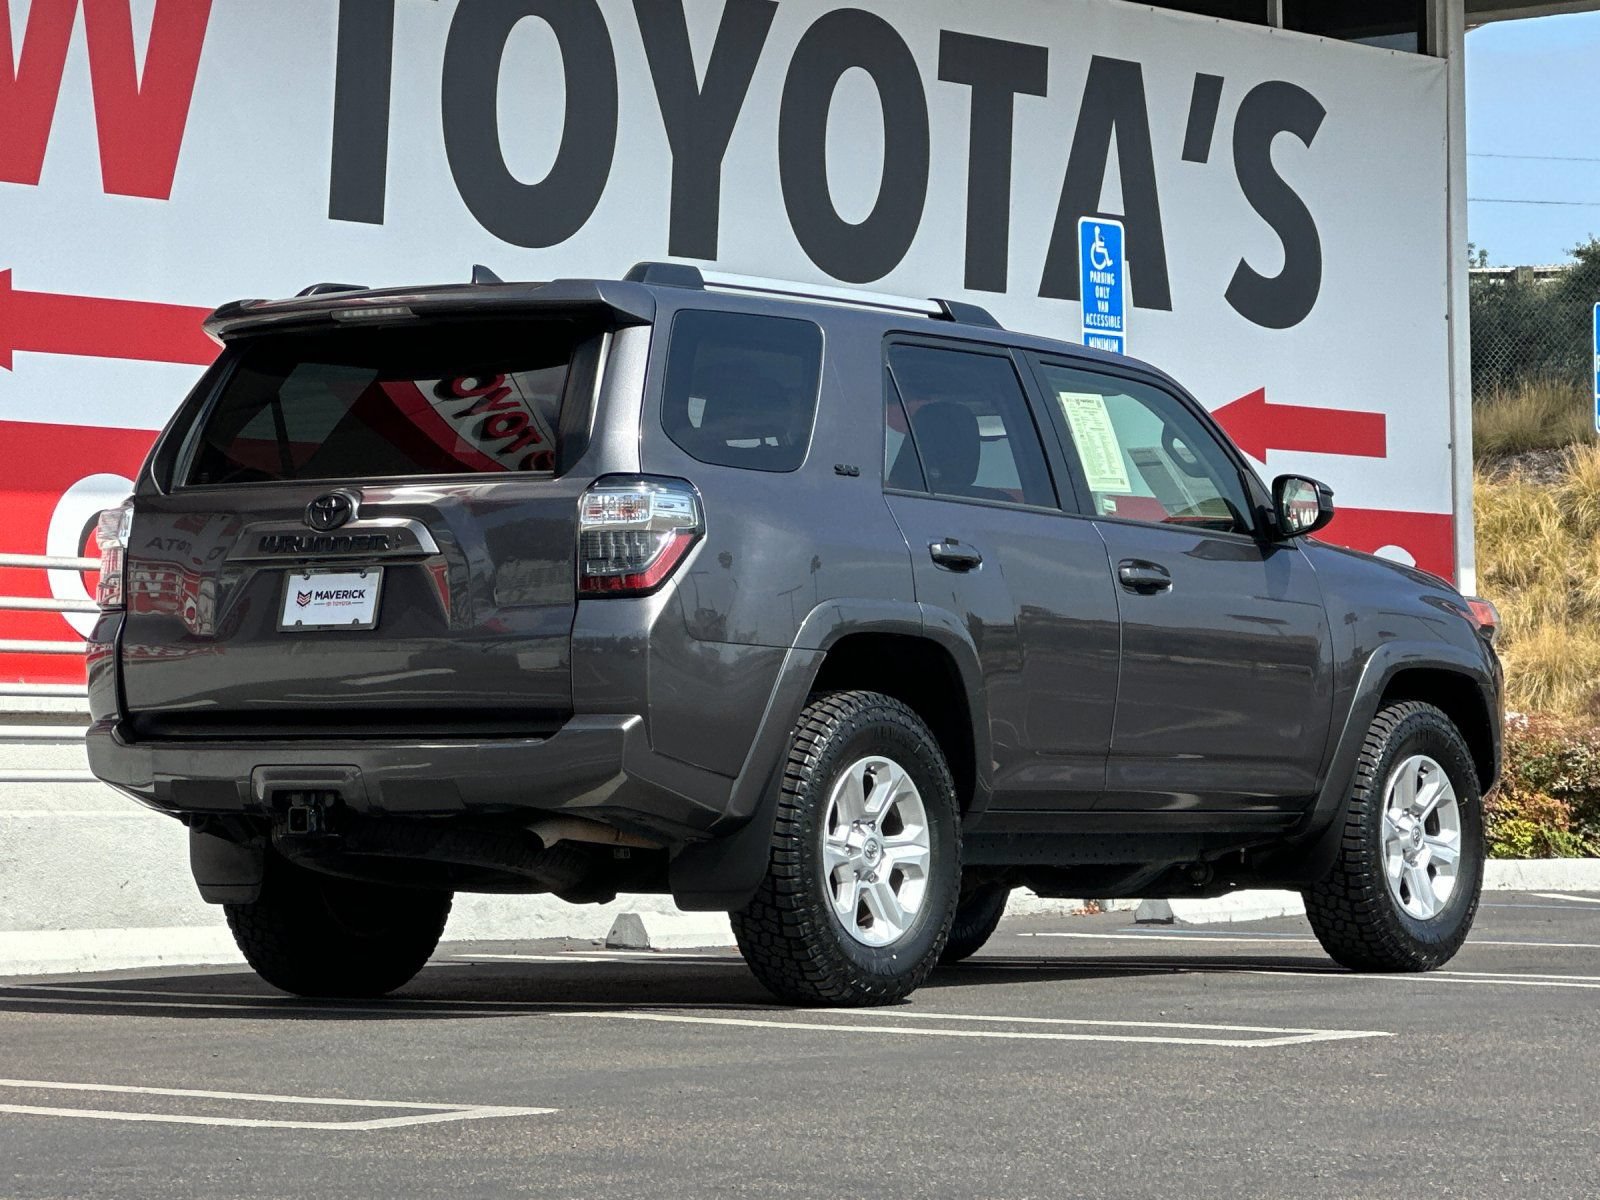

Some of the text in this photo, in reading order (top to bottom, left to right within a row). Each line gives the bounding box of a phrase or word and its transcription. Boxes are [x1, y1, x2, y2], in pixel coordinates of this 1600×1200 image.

[329, 0, 1326, 329] TOYOTA'S
[1090, 271, 1115, 285] PARKING
[1095, 285, 1110, 299] ONLY
[1097, 300, 1109, 313] VAN
[1086, 313, 1121, 329] ACCESSIBLE
[1088, 337, 1119, 353] MINIMUM
[314, 590, 366, 600] MAVERICK
